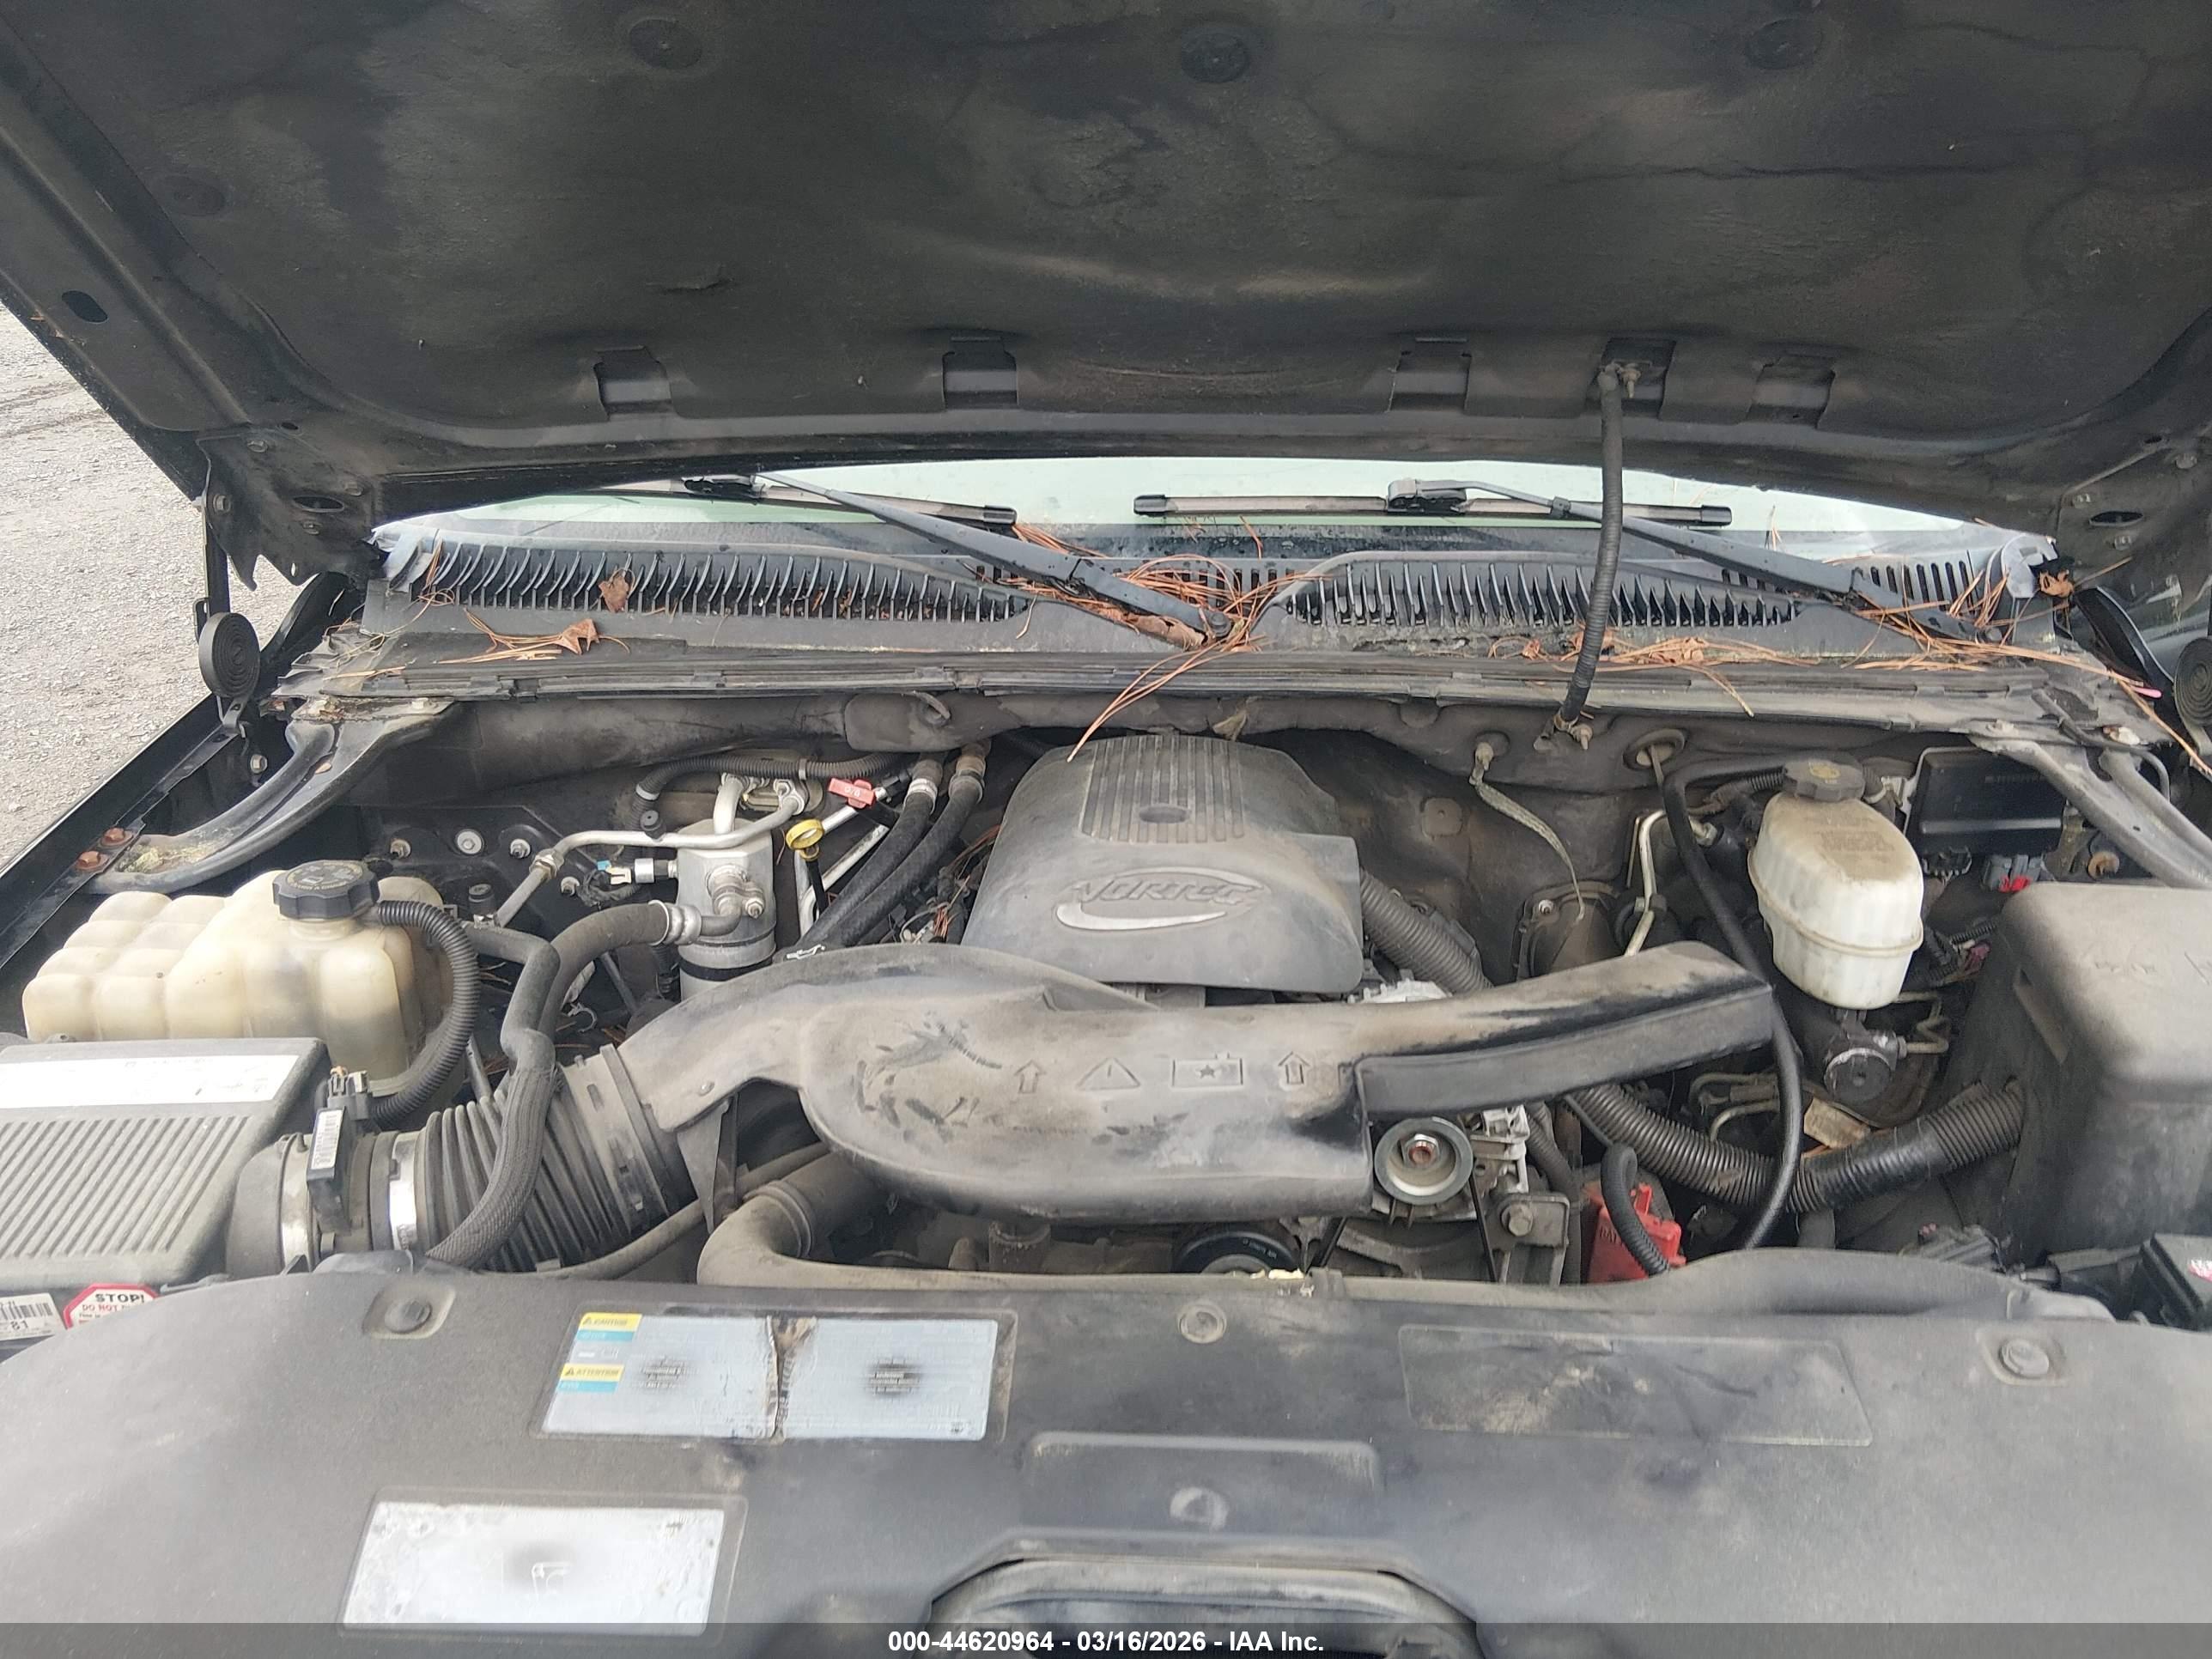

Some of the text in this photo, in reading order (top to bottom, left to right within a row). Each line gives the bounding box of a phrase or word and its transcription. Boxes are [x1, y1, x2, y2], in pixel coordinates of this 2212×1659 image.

[94, 1293, 145, 1304] STOP!
[98, 1304, 118, 1313] NOT
[593, 1317, 629, 1327] CAUTION
[576, 1368, 621, 1378] ATTENTION
